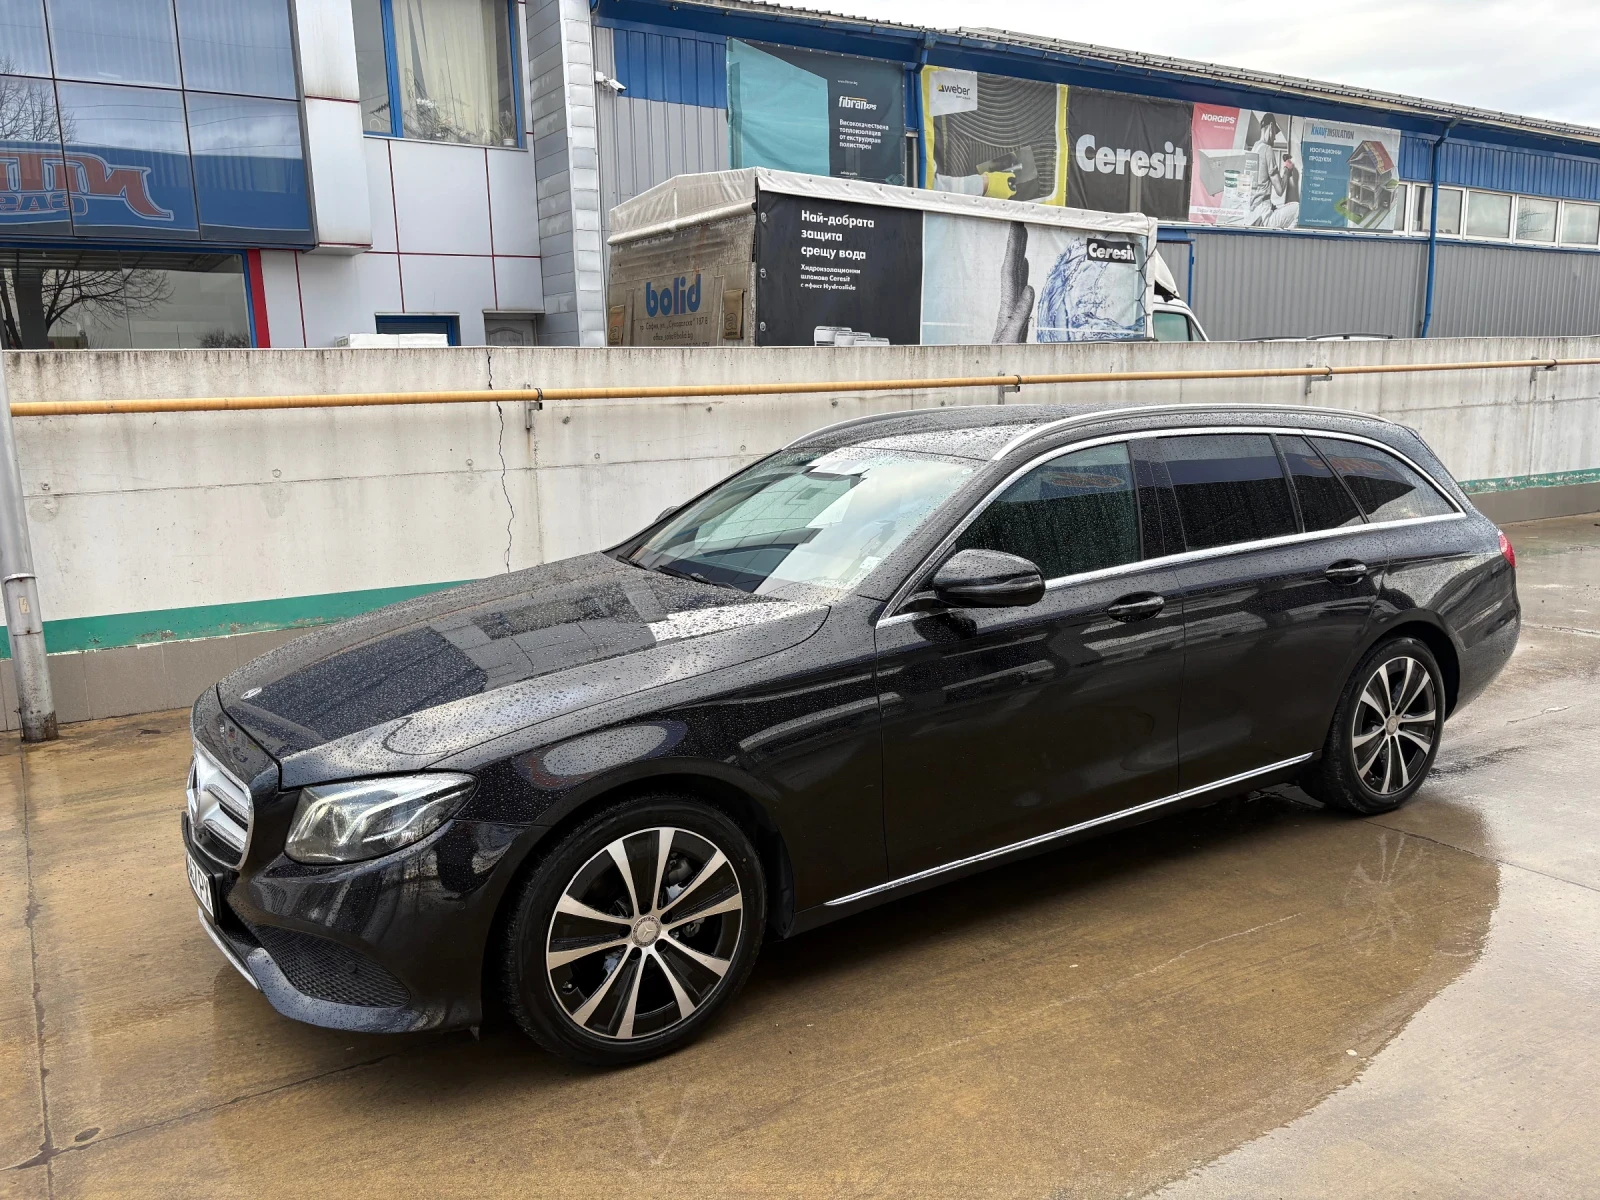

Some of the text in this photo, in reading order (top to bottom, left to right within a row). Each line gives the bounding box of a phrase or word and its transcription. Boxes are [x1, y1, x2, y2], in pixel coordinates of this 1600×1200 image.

[944, 84, 970, 95] weber
[1201, 113, 1236, 124] NORGIPS
[839, 119, 889, 130] Висококачествена
[839, 127, 881, 136] топлоизолация
[839, 141, 872, 150] полистирен
[846, 136, 881, 144] екструдиран
[1076, 134, 1187, 180] Ceresit
[801, 209, 875, 228] Най-добрата
[801, 229, 843, 242] защита
[801, 246, 866, 261] срещу вода
[800, 263, 861, 274] Хидроизолационни
[823, 283, 856, 291] Hydroslide
[646, 273, 701, 318] bolid
